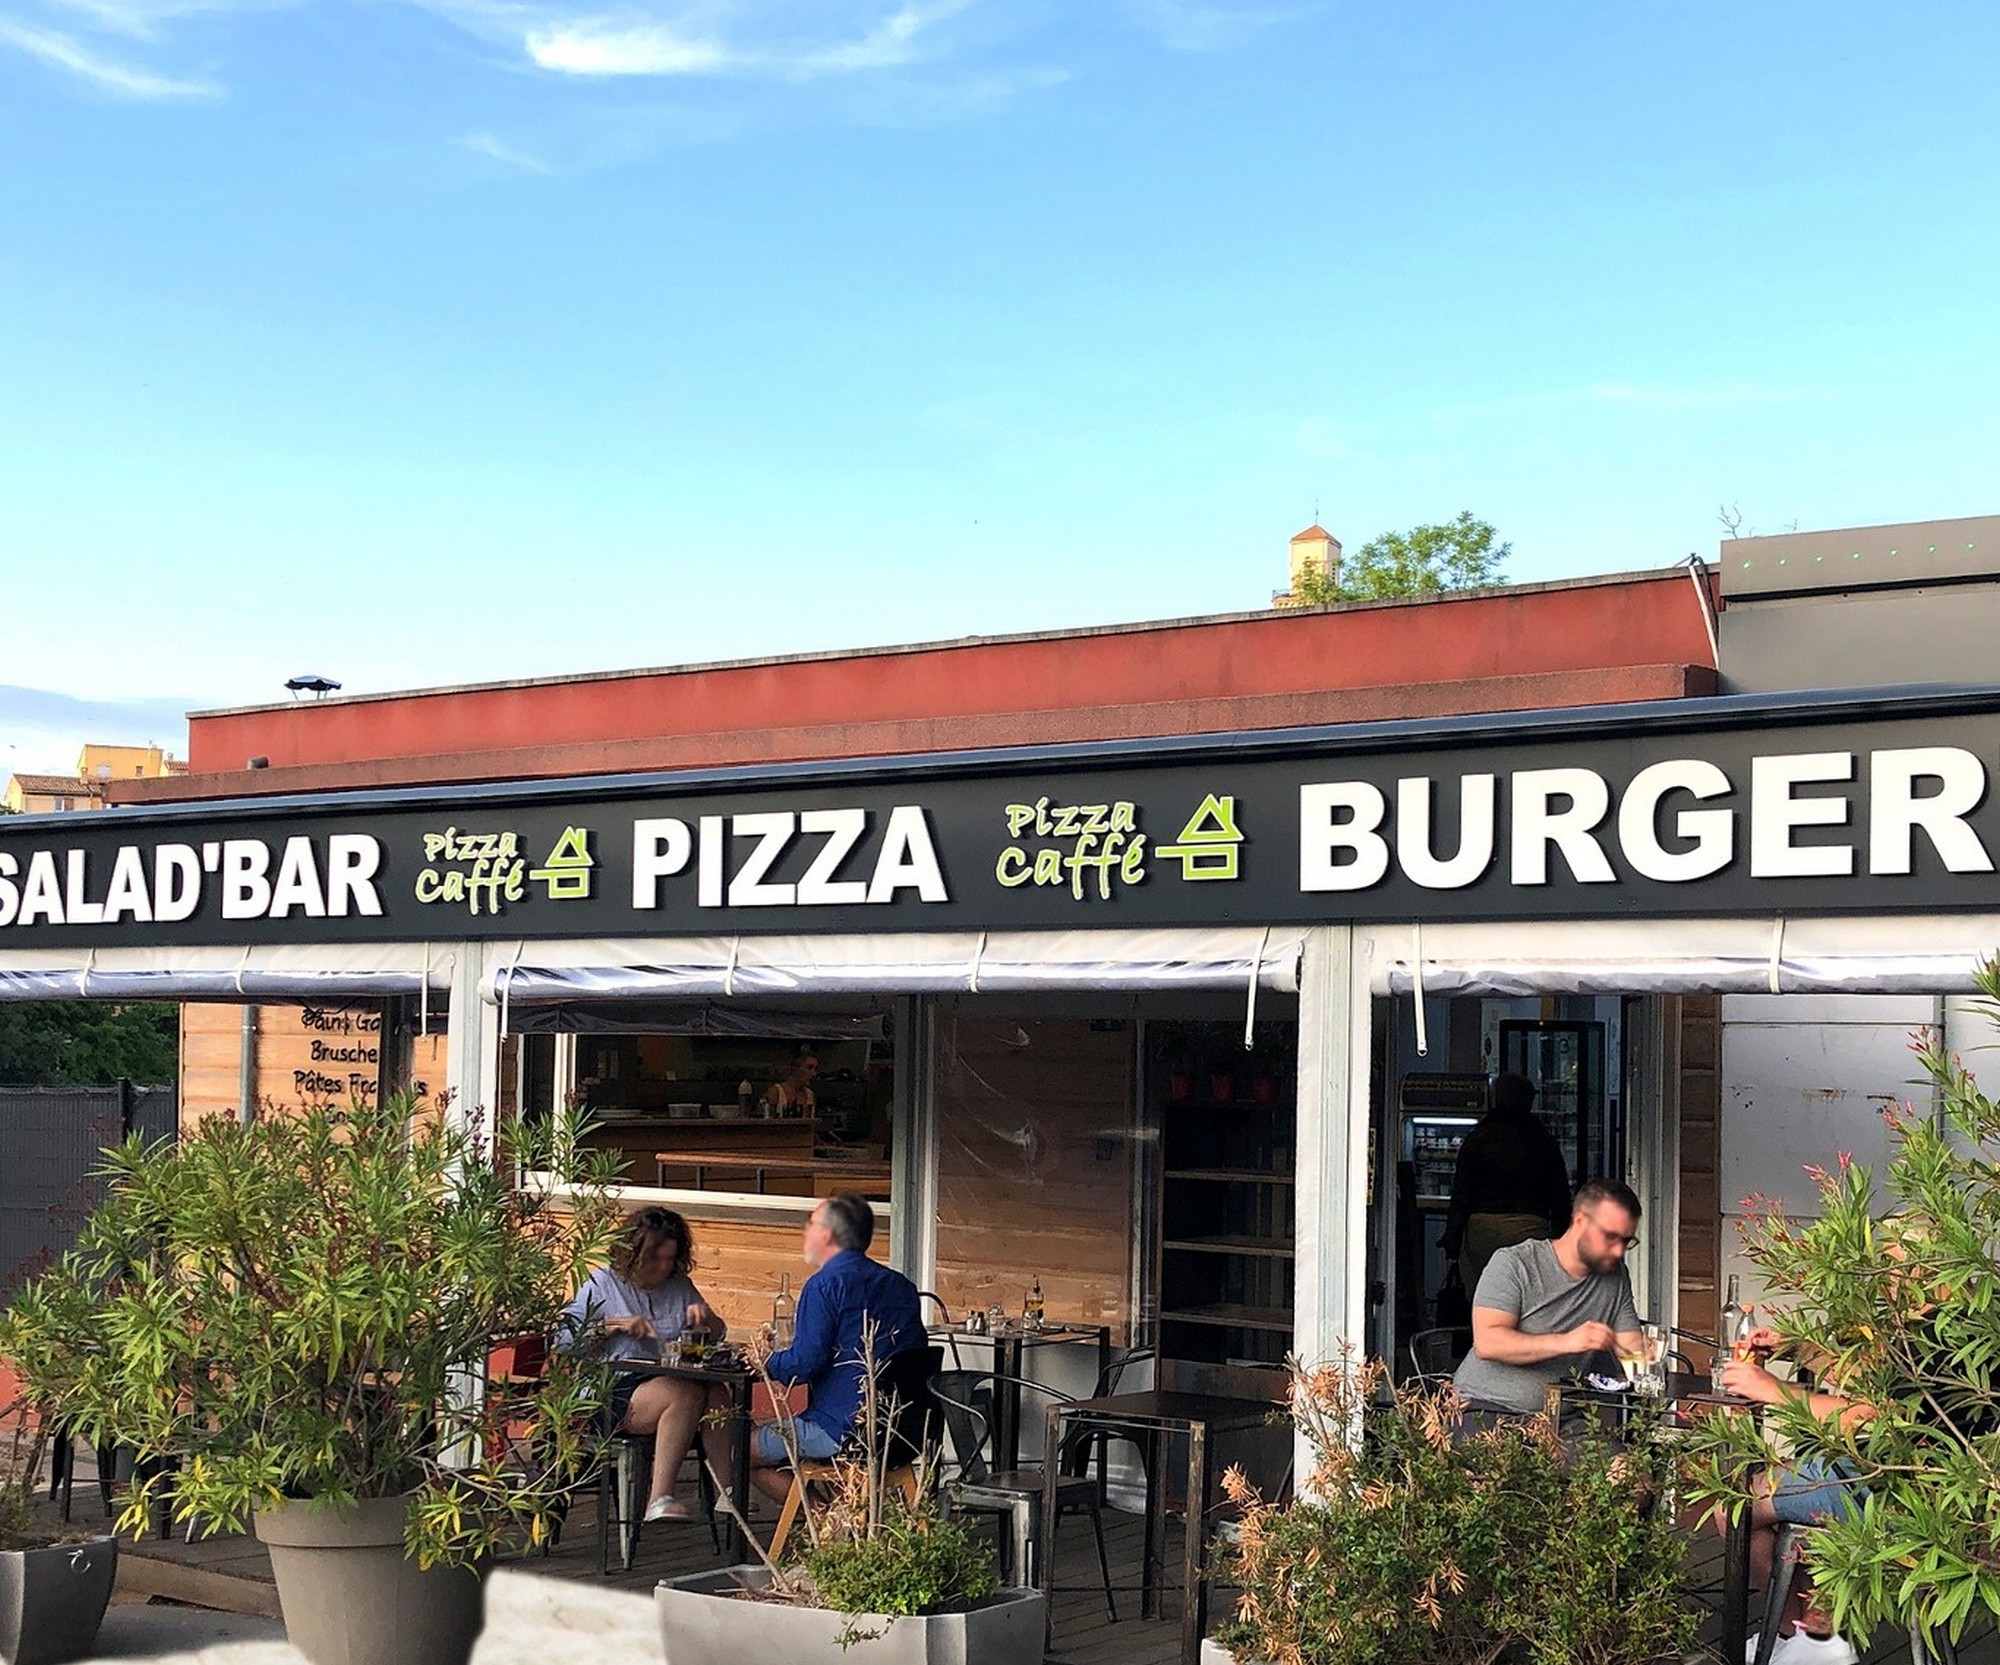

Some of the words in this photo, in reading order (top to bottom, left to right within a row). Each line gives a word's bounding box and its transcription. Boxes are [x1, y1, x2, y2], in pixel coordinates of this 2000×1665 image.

[1005, 796, 1136, 838] Pizza
[1300, 747, 1995, 892] BURGER
[423, 827, 518, 862] Pizza
[632, 805, 949, 909] PIZZA
[0, 834, 383, 926] SALAD'BAR
[311, 1040, 378, 1063] Brusche
[293, 1070, 342, 1094] Pâtes
